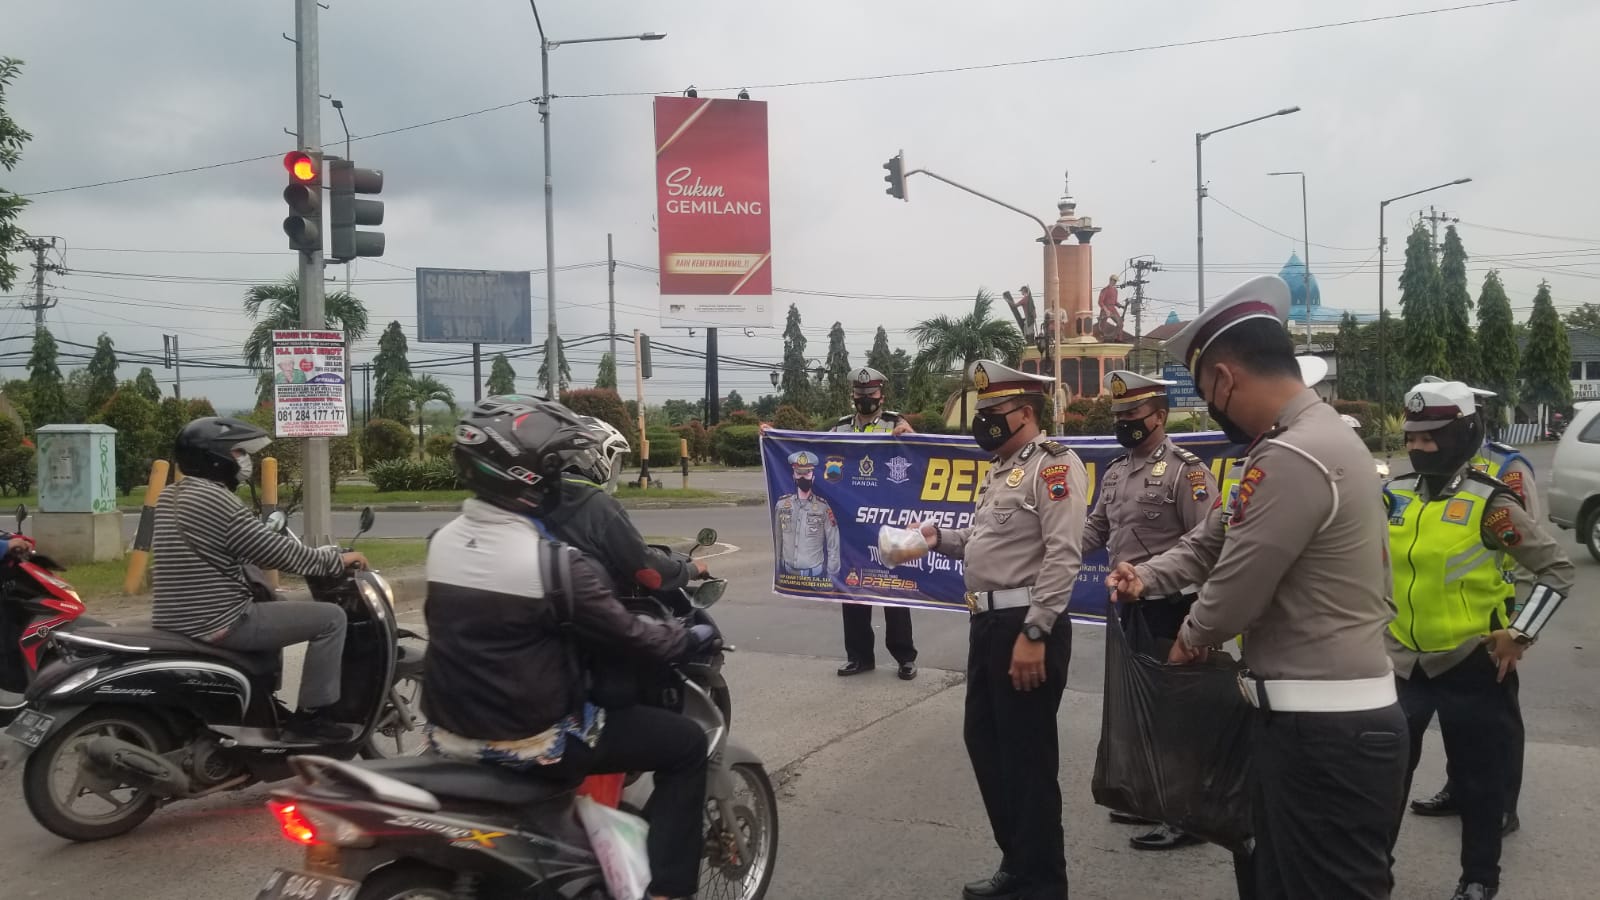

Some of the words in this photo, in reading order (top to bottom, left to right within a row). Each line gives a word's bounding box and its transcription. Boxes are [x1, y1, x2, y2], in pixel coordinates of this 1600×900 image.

[666, 167, 725, 197] Sukun
[666, 200, 762, 215] GEMILANG
[278, 410, 292, 421] 081
[295, 410, 310, 421] 284
[313, 410, 328, 421] 177
[331, 410, 345, 421] 177
[856, 506, 956, 528] SATLANTAS
[862, 576, 918, 589] PRESISI
[95, 685, 156, 696] Scoopy
